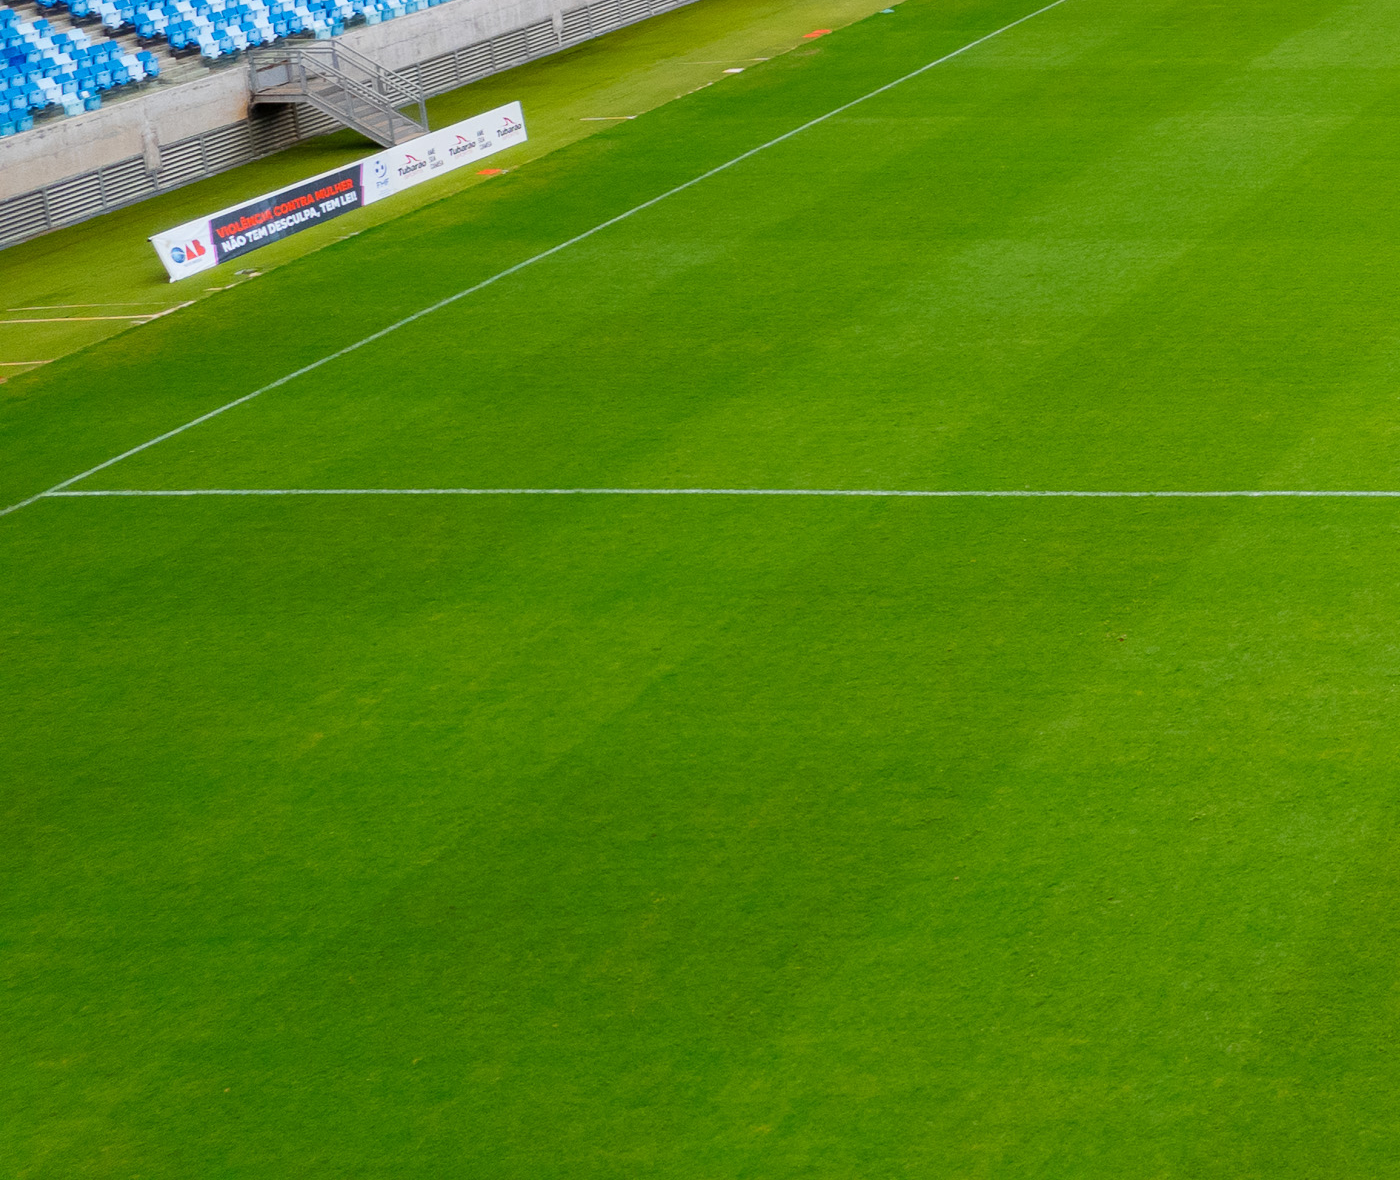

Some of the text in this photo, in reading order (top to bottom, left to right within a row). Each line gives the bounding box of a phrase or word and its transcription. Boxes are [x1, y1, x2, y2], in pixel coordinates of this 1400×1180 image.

[216, 178, 354, 238] VIOLÊNCIA CONTRA MULHER
[221, 235, 247, 252] NÃO
[245, 225, 269, 242] TEM
[267, 207, 320, 234] DESCULPA,
[319, 197, 341, 214] TEM
[340, 191, 358, 206] LEI!
